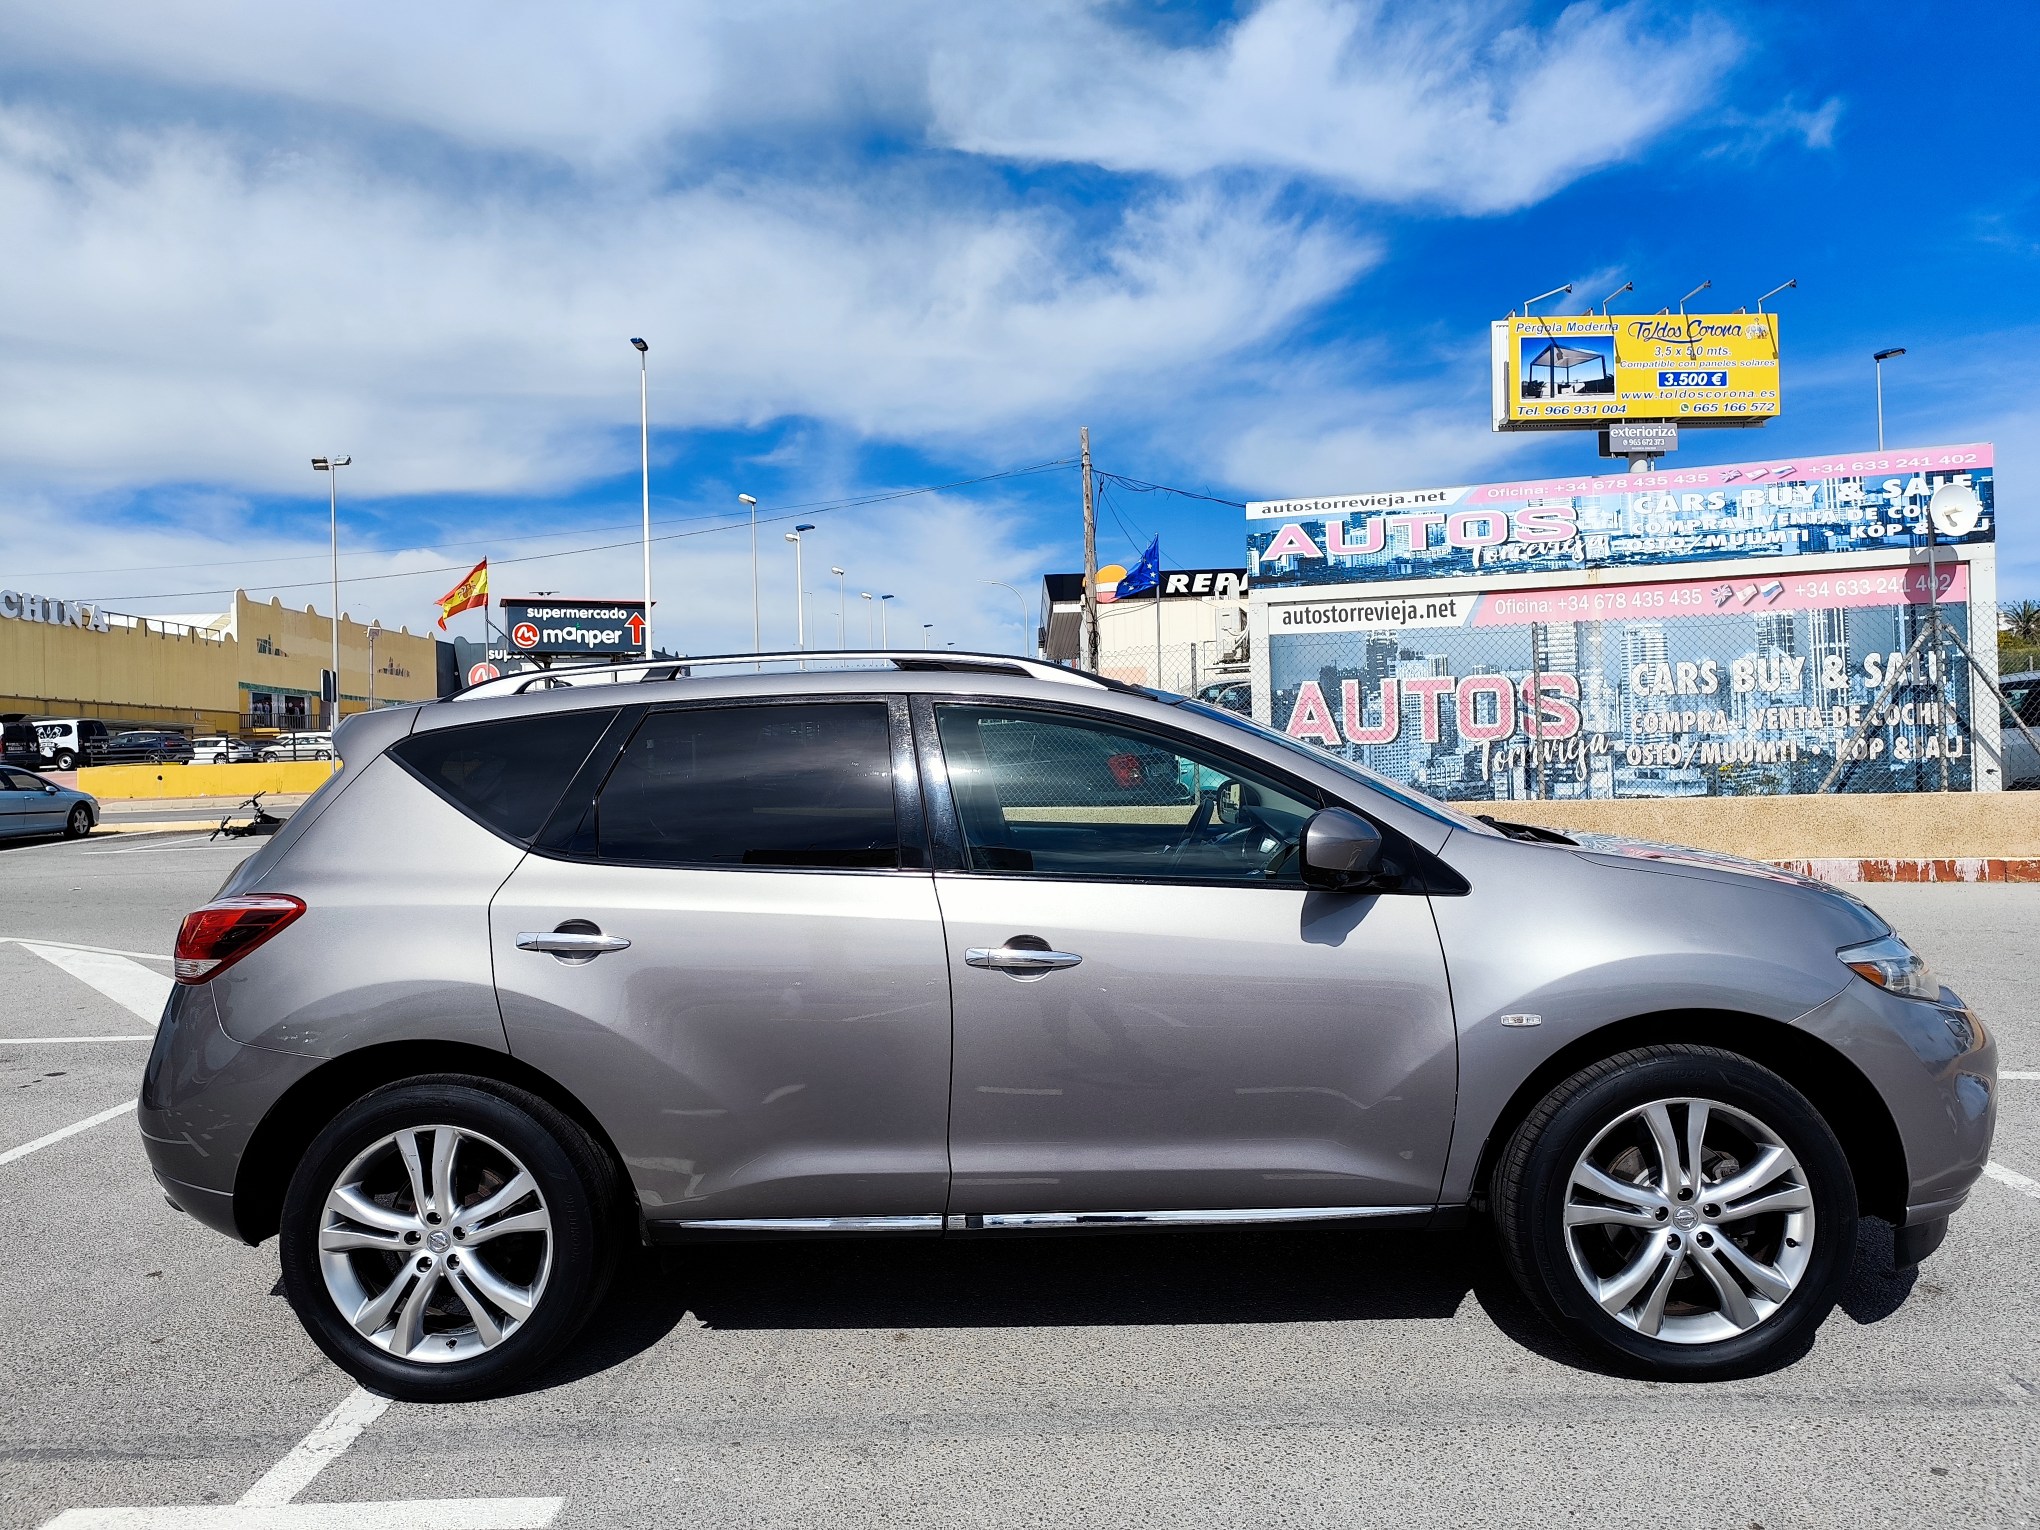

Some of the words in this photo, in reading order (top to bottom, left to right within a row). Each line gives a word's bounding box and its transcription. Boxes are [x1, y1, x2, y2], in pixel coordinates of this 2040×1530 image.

[1516, 322, 1562, 335] Pérgola
[1566, 322, 1619, 332] Moderna
[1628, 321, 1682, 342] Toldos
[1687, 320, 1743, 340] Corona
[1654, 346, 1672, 357] 3,5
[1706, 346, 1731, 356] mts.
[1620, 359, 1675, 369] Compatible
[1700, 360, 1736, 368] paneles
[1740, 359, 1775, 367] solares
[1664, 373, 1708, 386] 3.500
[1711, 373, 1723, 386] €
[1621, 389, 1775, 400] www.toldoscorona.es
[1517, 406, 1541, 416] Tel.
[1544, 405, 1570, 415] 966
[1573, 405, 1597, 415] 931
[1602, 404, 1627, 414] 004
[1693, 403, 1718, 412] 665
[1723, 402, 1746, 411] 166
[1750, 402, 1775, 411] 572
[1610, 426, 1677, 437] exterioriza
[1262, 491, 1447, 515] autostorrevieja.net
[1487, 486, 1549, 499] Oficina:
[1554, 481, 1588, 492] +34
[1593, 479, 1628, 490] 678
[1633, 476, 1668, 487] 435
[1673, 473, 1709, 485] 435
[1808, 462, 1846, 474] +34
[1851, 460, 1890, 471] 633
[1896, 456, 1933, 468] 241
[1939, 453, 1977, 465] 402
[1260, 506, 1578, 562] AUTOS
[1633, 491, 1726, 515] CARS
[1741, 484, 1820, 508] BUY
[1837, 482, 1867, 501] &
[1631, 516, 1736, 535] COMPRA
[1760, 508, 1839, 528] VENTA
[1847, 507, 1878, 521] DE
[1851, 521, 1903, 539] KÖP
[1466, 534, 1611, 569] Torrevieja
[1282, 599, 1457, 625] autostorrevieja.net
[1495, 599, 1552, 615] Oficina:
[1558, 595, 1589, 611] +34
[1594, 593, 1626, 609] 678
[1632, 591, 1664, 607] 435
[1669, 589, 1703, 605] 435
[1795, 581, 1830, 598] +34
[1835, 579, 1871, 596] 633
[1876, 576, 1911, 594] 241
[1915, 574, 1951, 591] 402
[0, 589, 110, 633] CHINA
[526, 607, 627, 621] supermercado
[542, 626, 622, 649] manper
[1286, 672, 1583, 746] AUTOS
[1631, 660, 1719, 697] CARS
[1733, 656, 1806, 693] BUY
[1821, 654, 1850, 690] &
[1631, 709, 1729, 735] COMPRA
[1751, 706, 1824, 731] VENTA
[1832, 705, 1861, 727] DE
[1475, 730, 1610, 782] Torrvieja
